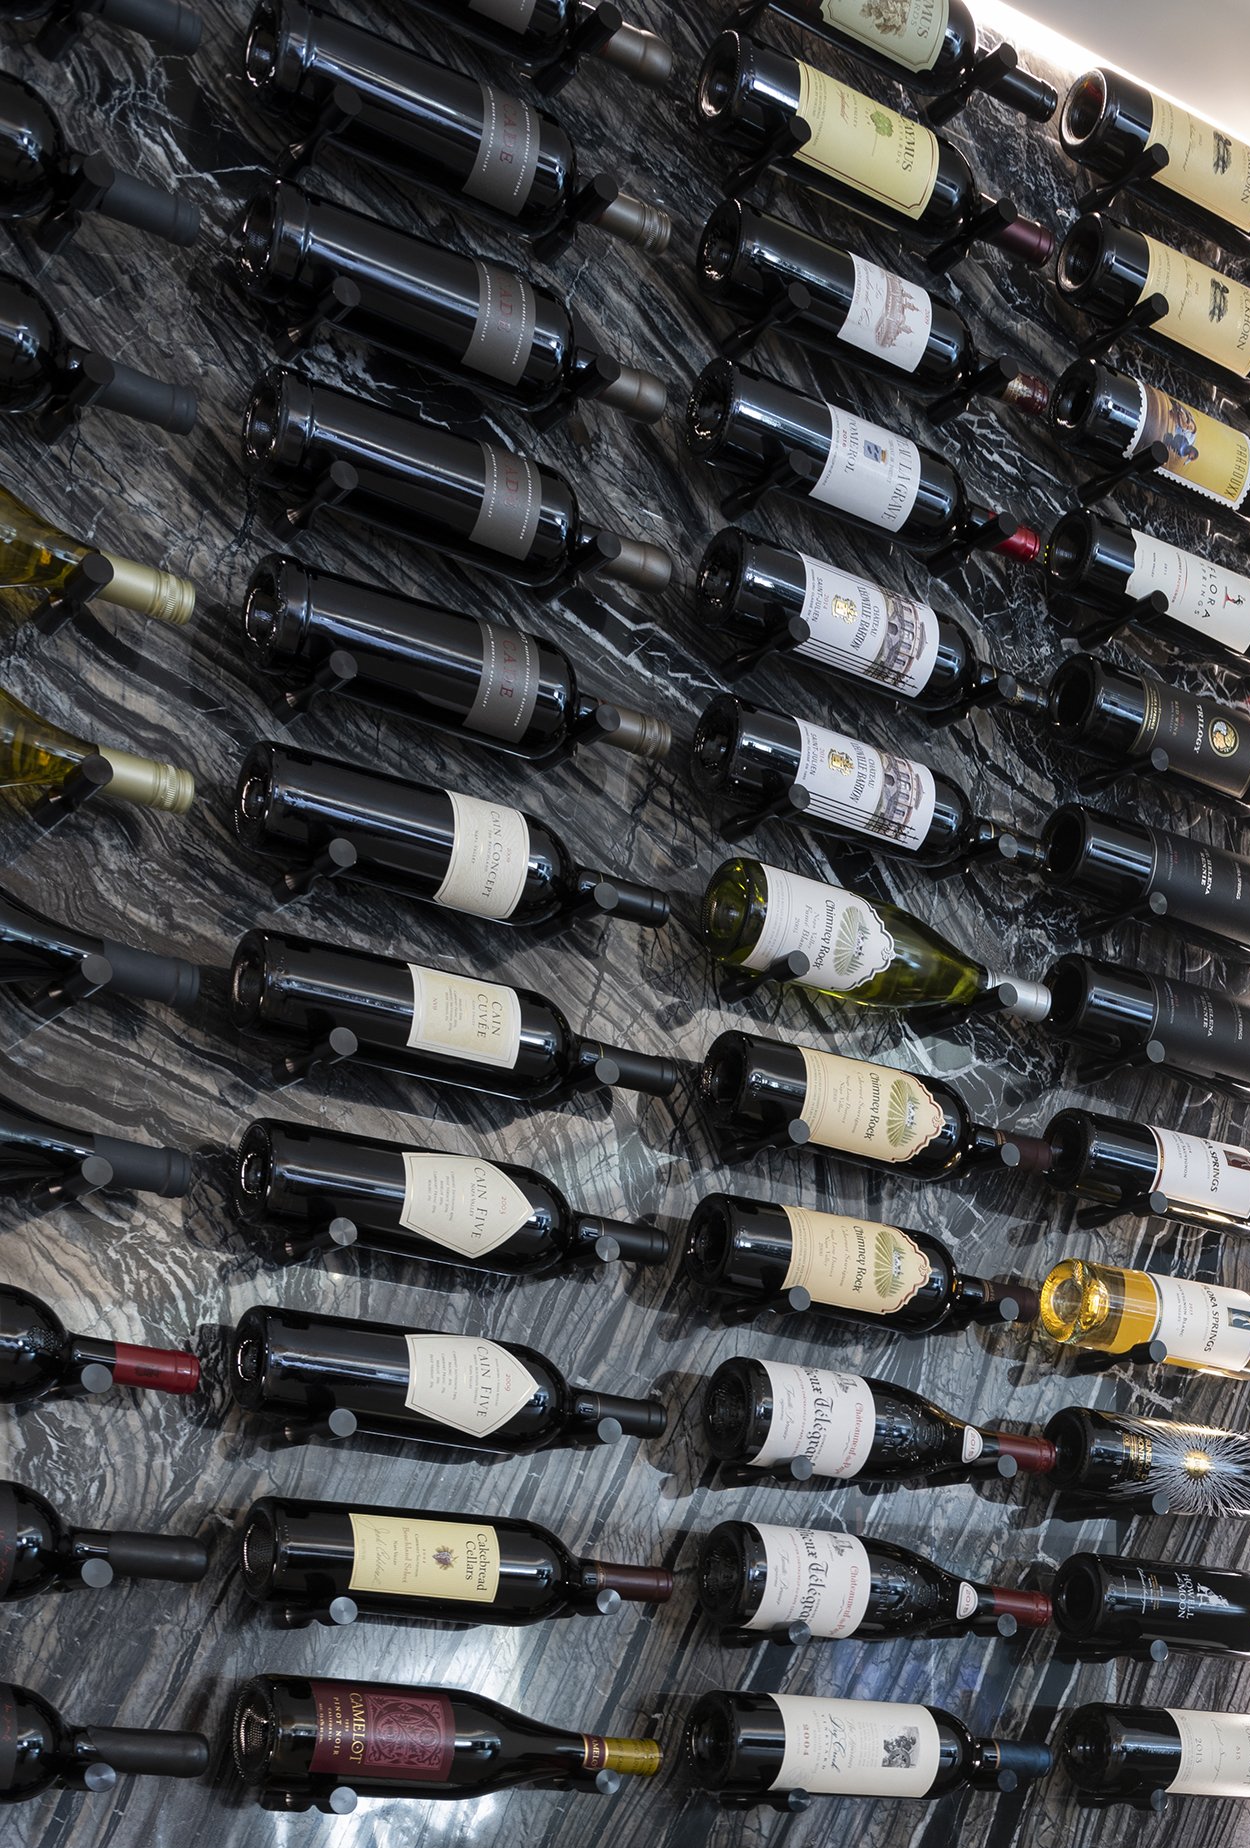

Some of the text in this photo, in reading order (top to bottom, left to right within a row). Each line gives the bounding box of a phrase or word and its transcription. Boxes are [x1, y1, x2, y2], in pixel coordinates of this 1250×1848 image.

[1201, 566, 1217, 618] FLORA
[1193, 704, 1204, 754] TRILOGY
[481, 810, 503, 898] CAIN CONCEPT
[812, 899, 835, 970] Chimney Rock
[477, 993, 488, 1038] CUVÉE
[491, 1001, 504, 1036] CAIN
[864, 1072, 881, 1140] Chimney Rock
[1208, 1152, 1221, 1193] SPRINGS
[470, 1167, 488, 1239] CAIN FIVE
[852, 1225, 866, 1292] Chimney Rock
[1204, 1312, 1221, 1353] SPRINGS
[476, 1346, 492, 1418] CAIN FIVE
[465, 1540, 477, 1581] Cellars
[476, 1533, 488, 1592] Cakebread
[333, 1697, 342, 1756] PINOT NOIR
[348, 1692, 365, 1764] CAMELOT
